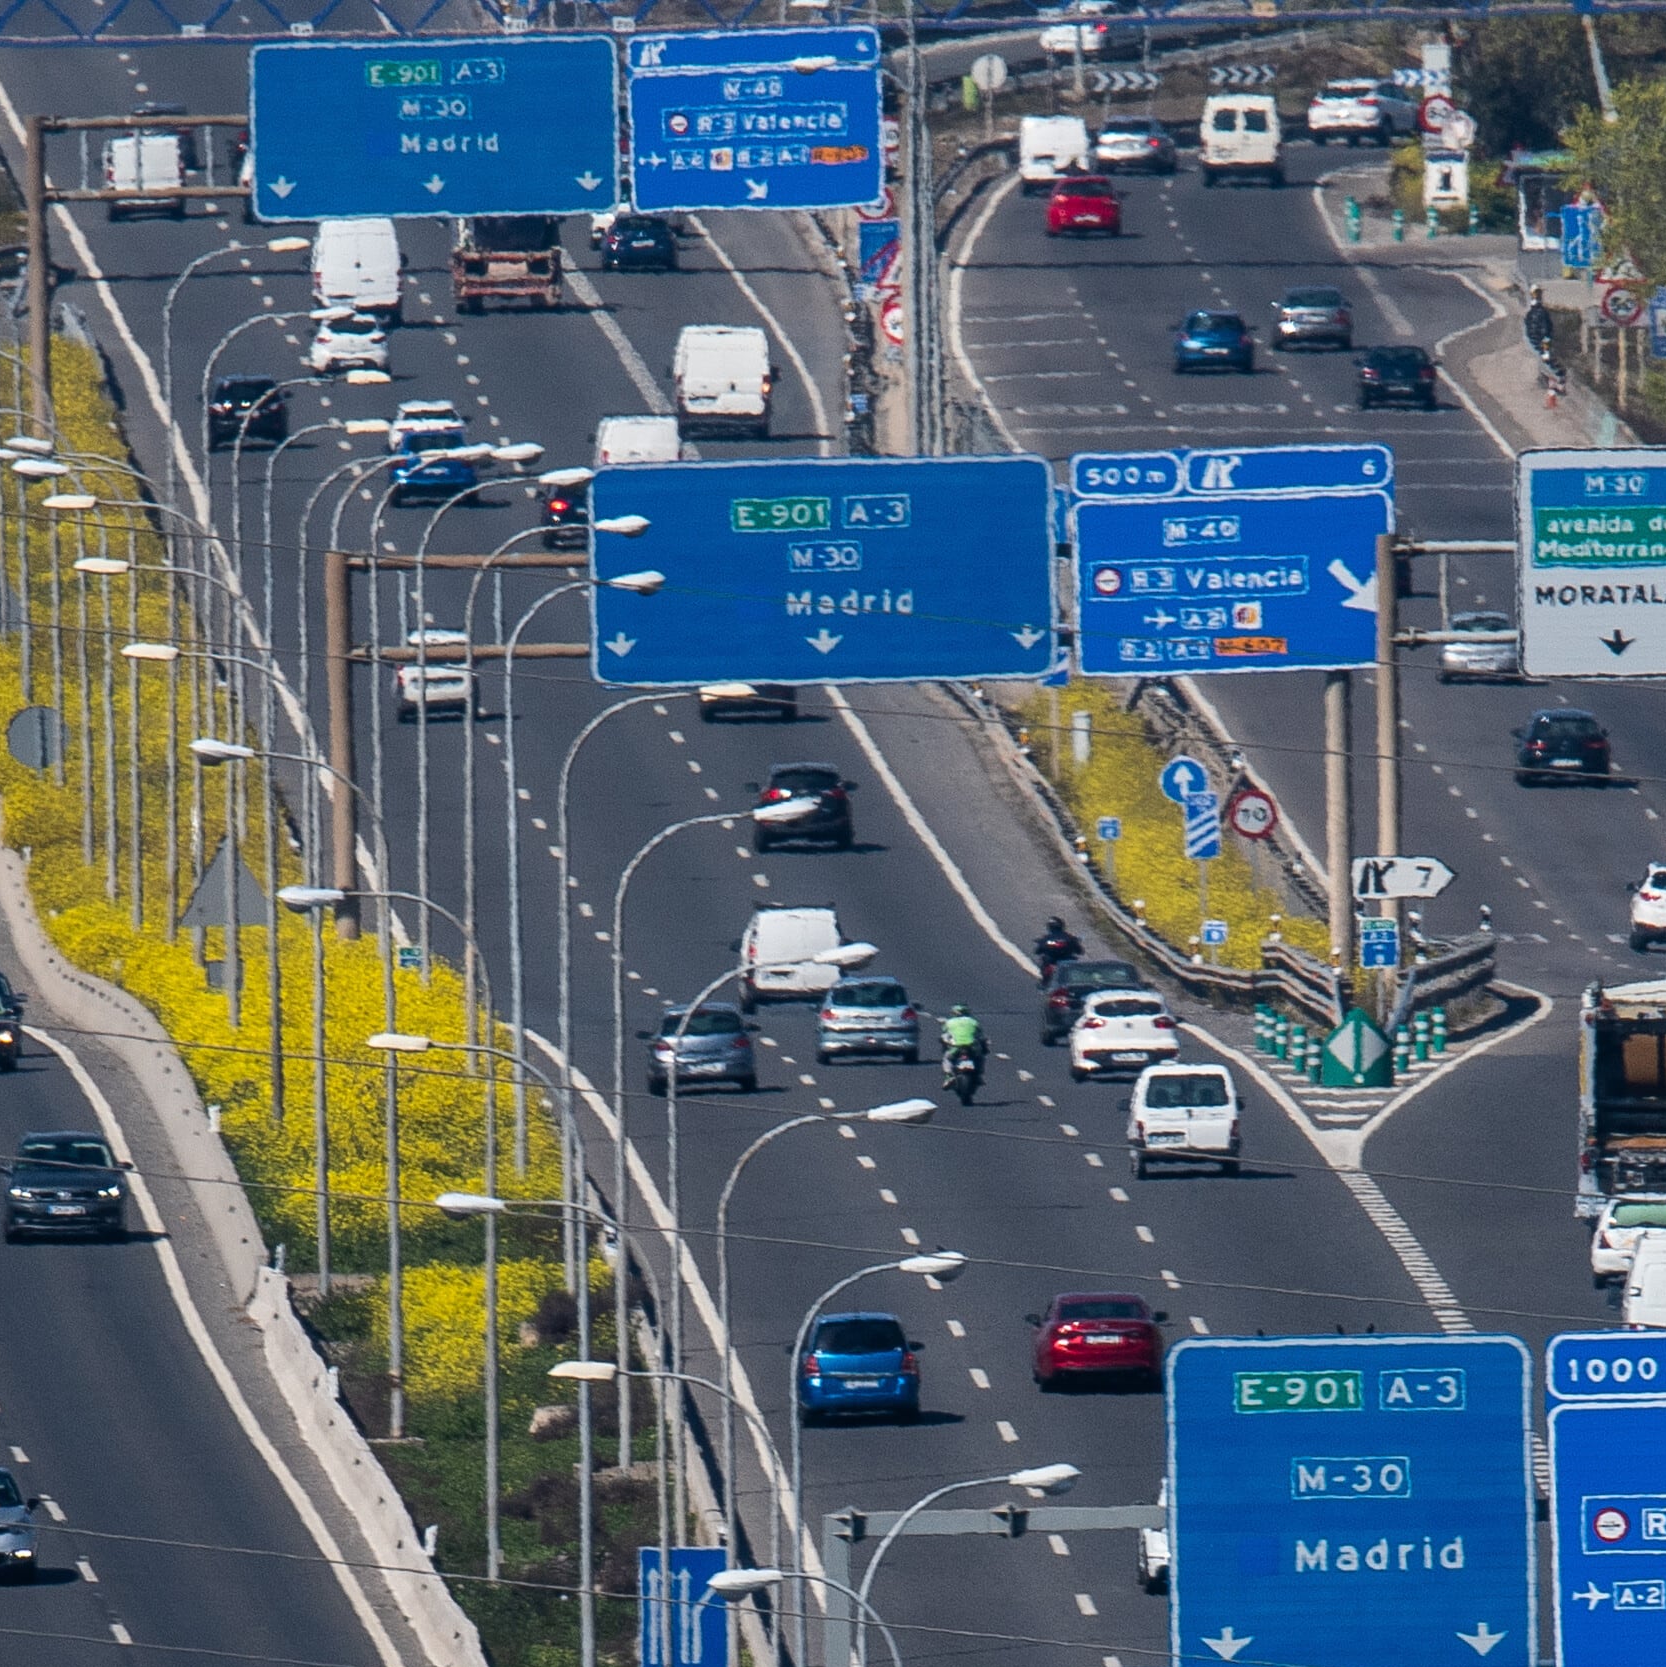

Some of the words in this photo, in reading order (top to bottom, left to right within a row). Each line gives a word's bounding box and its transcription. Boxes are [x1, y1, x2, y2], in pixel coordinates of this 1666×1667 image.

[370, 65, 438, 85] E-901
[457, 61, 500, 80] A-3
[403, 100, 466, 116] M-30
[743, 114, 842, 130] Valencia
[400, 133, 499, 153] Madrid
[1086, 467, 1139, 486] 500
[1146, 470, 1165, 483] m
[1586, 476, 1643, 492] M-30
[736, 503, 827, 526] E-901
[851, 500, 904, 523] A-3
[1547, 514, 1635, 534] avenida
[1167, 522, 1237, 540] M-40
[793, 546, 857, 568] M-30
[1186, 566, 1303, 590] Valencia
[786, 590, 914, 617] Madrid
[1416, 865, 1433, 888] 7
[1566, 1356, 1659, 1384] 1000
[1241, 1378, 1357, 1407] E-901
[1386, 1376, 1459, 1403] A-3
[1297, 1464, 1404, 1494] M-30
[1295, 1536, 1464, 1573] Madrid
[1619, 1582, 1662, 1607] A-2
